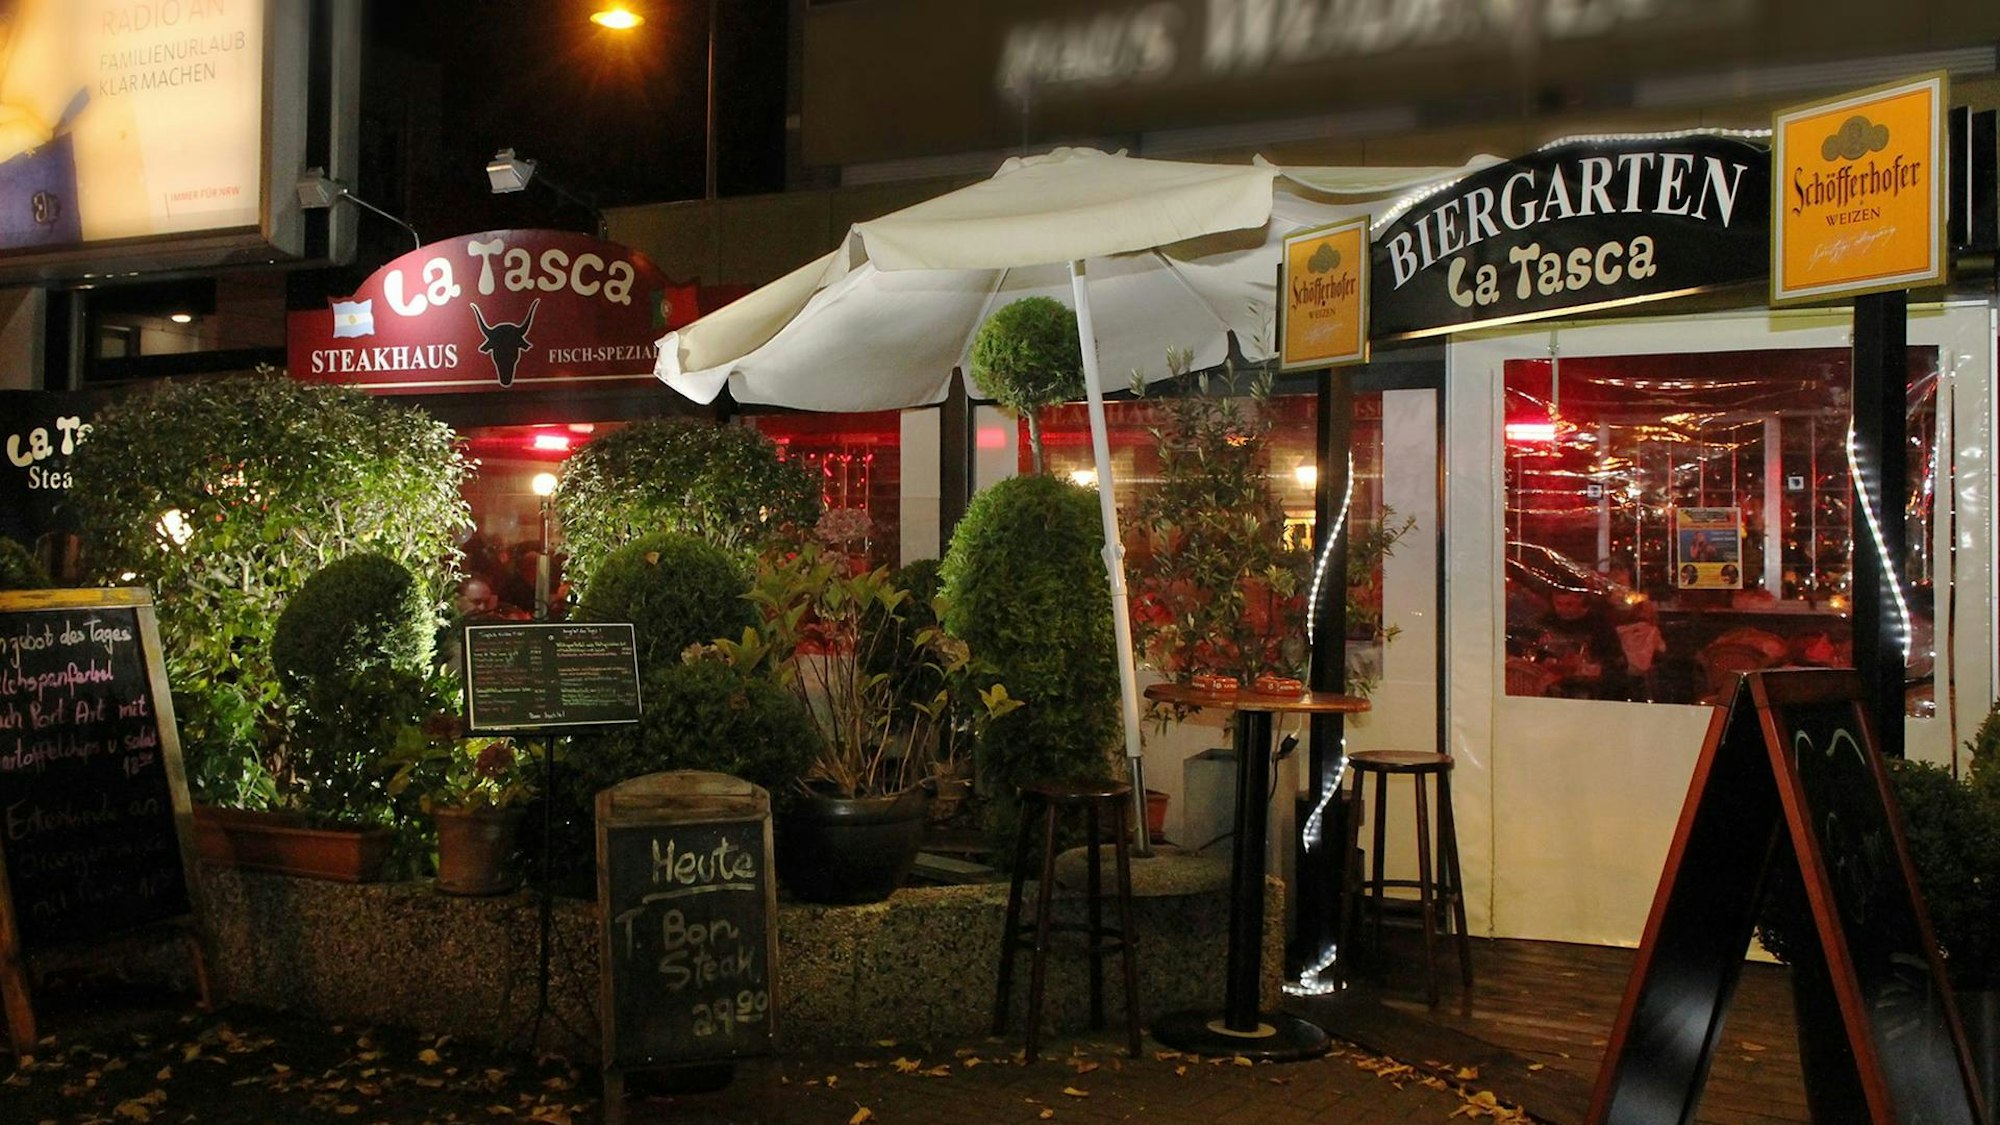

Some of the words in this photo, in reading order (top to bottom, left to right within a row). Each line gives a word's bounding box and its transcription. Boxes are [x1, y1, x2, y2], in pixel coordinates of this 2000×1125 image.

[102, 0, 181, 36] RADIO
[100, 31, 246, 71] FAMILIENURLAUB
[99, 62, 216, 97] KLARMACHEN
[1793, 154, 1921, 217] Schöfferhofer
[1385, 152, 1748, 291] BIERGARTEN
[1826, 207, 1881, 226] WEIZEN
[384, 257, 460, 316] La
[468, 238, 636, 306] Tasca
[1292, 271, 1356, 311] Schöfferhofer
[1447, 256, 1500, 308] La
[1509, 235, 1657, 300] Tasca
[311, 343, 458, 374] STEAKHAUS
[7, 427, 53, 467] La
[60, 620, 85, 646] des
[83, 618, 131, 655] Tages
[119, 694, 147, 720] mit
[652, 837, 757, 885] Heute
